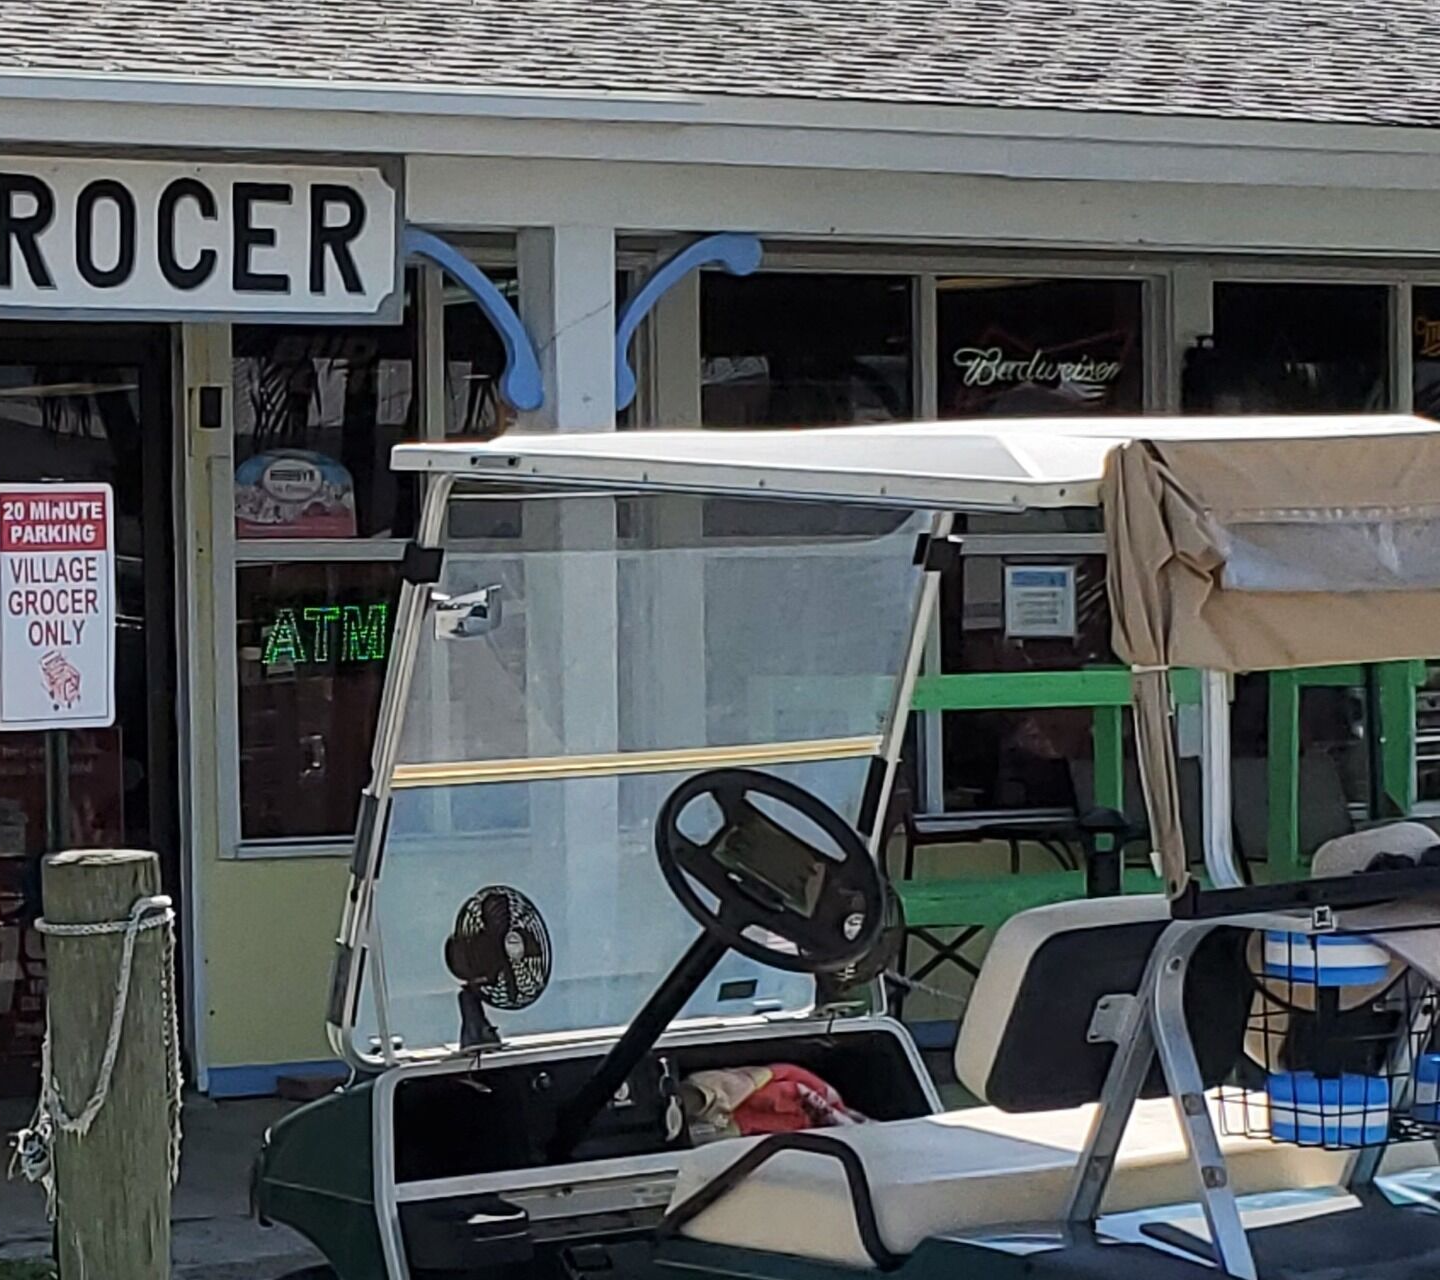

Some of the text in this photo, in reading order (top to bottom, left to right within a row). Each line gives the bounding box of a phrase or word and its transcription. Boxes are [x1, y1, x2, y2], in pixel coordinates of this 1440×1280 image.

[953, 347, 1120, 386] Budweiser
[3, 502, 103, 520] 20 MINUTE
[11, 524, 96, 544] PARKING
[9, 557, 97, 584] VILLAGE
[8, 589, 99, 616] GROCER
[28, 620, 86, 647] ONLY
[261, 604, 387, 664] ATM
